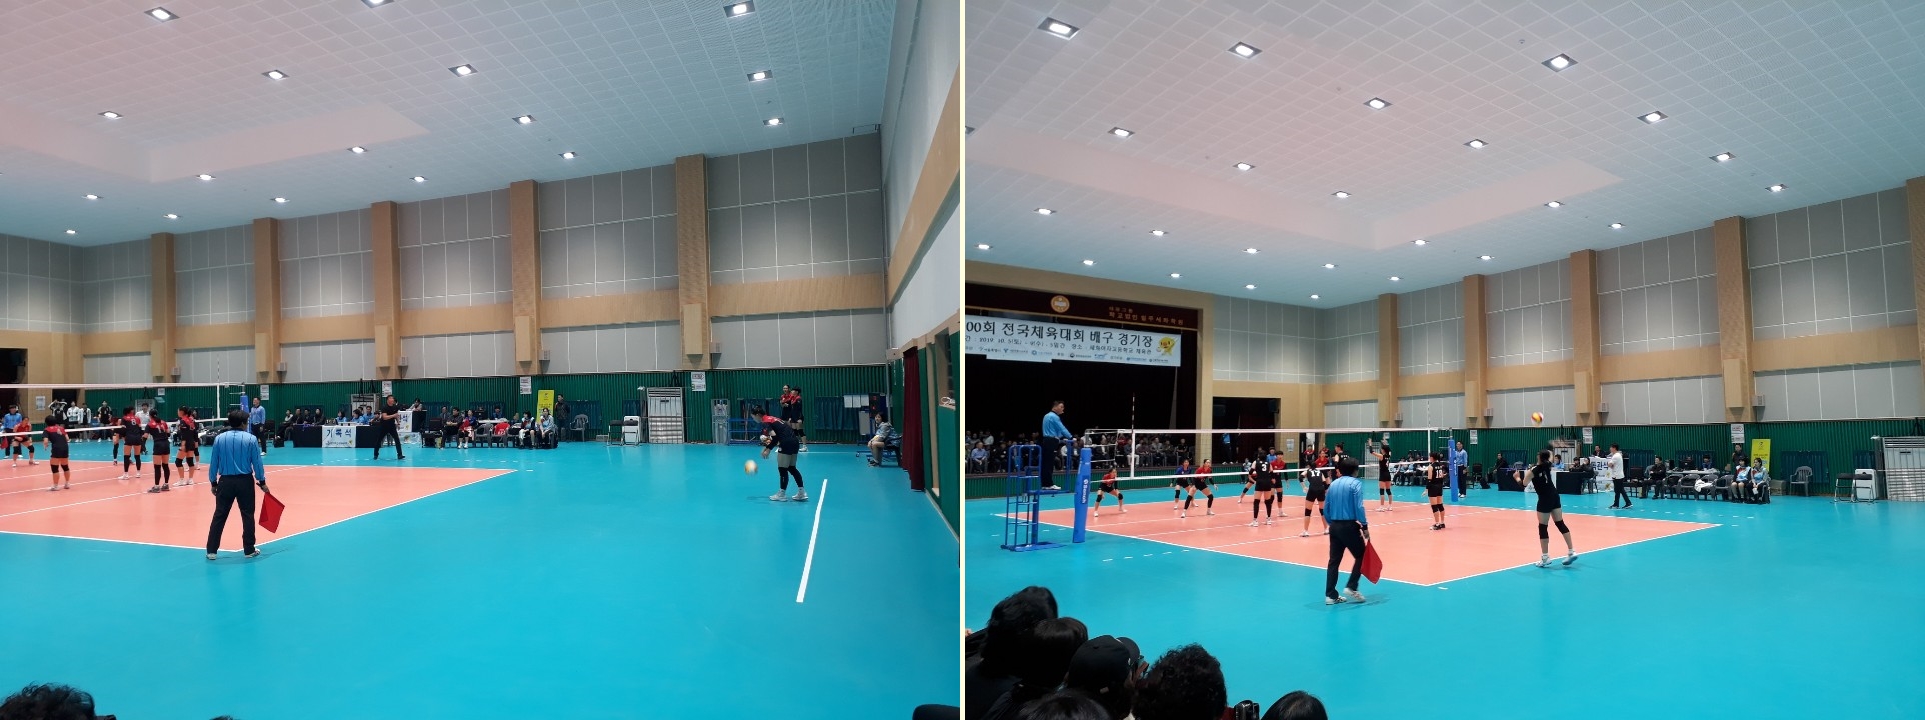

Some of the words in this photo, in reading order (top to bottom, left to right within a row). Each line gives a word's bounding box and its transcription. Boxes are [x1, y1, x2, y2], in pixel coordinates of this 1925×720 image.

[1001, 322, 1085, 342] 전국체육대회
[1089, 330, 1114, 344] 배구
[1118, 333, 1153, 348] 경기장
[327, 428, 352, 438] 기록석
[1261, 463, 1267, 472] 3
